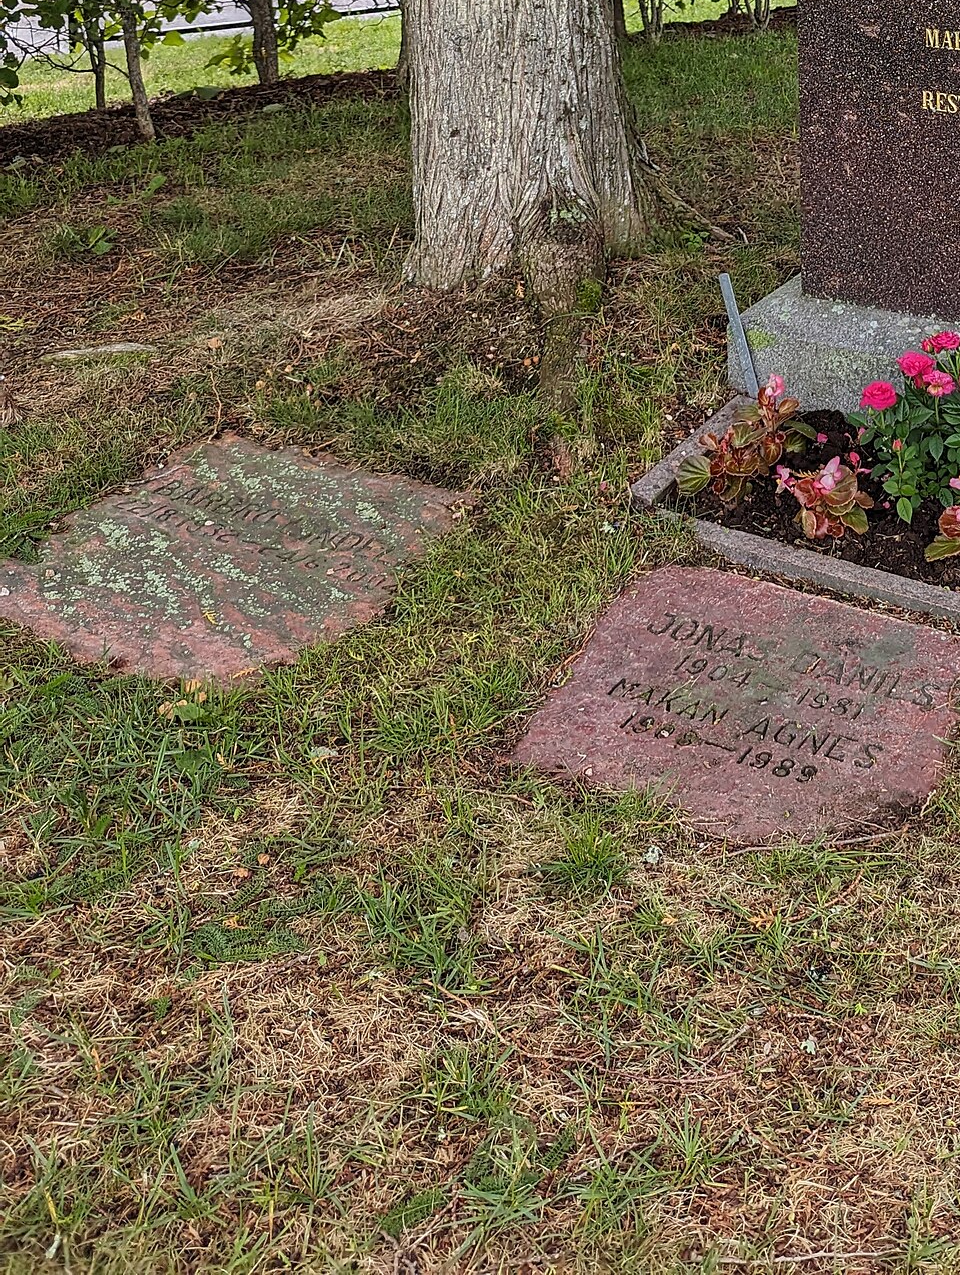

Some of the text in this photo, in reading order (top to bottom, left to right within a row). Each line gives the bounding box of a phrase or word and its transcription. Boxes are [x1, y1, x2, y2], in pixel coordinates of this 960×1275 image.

[648, 612, 766, 662] JONAS
[673, 654, 752, 689] 1904
[796, 688, 866, 722] 1981
[607, 677, 885, 769] MAKAN AGNES
